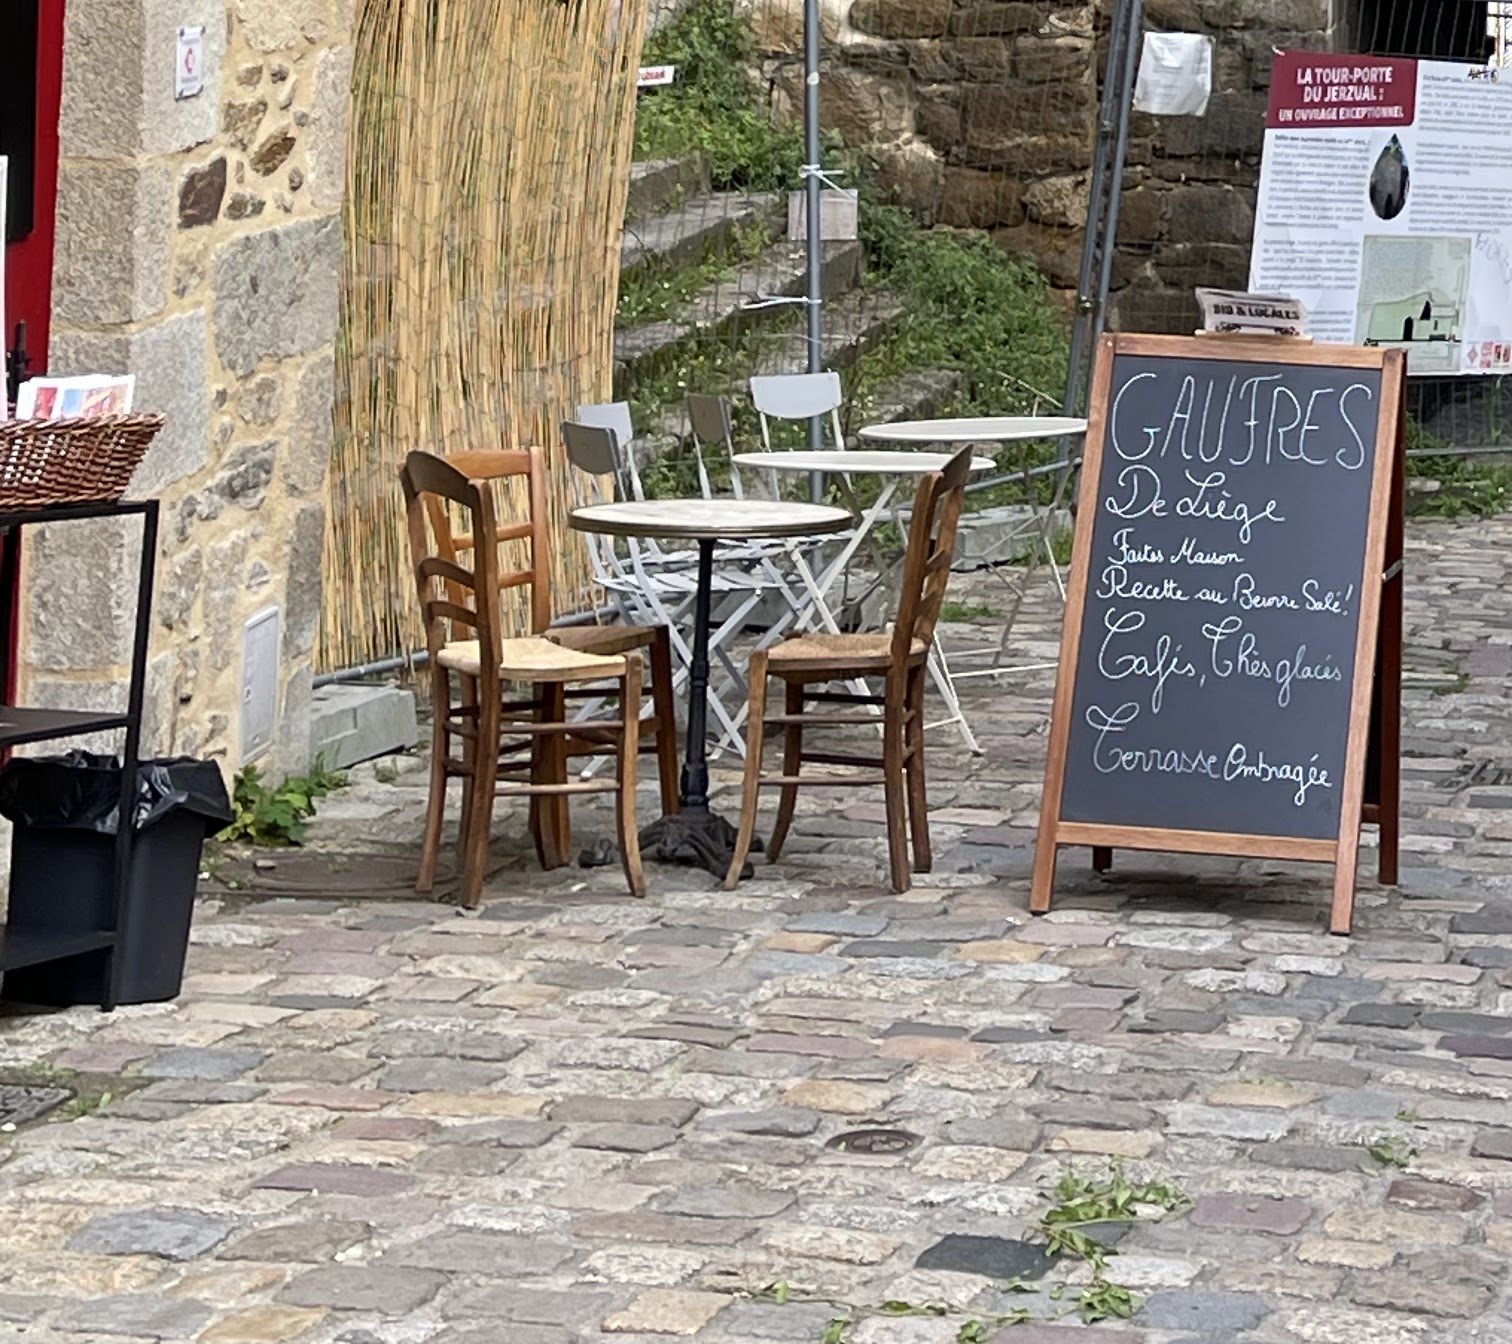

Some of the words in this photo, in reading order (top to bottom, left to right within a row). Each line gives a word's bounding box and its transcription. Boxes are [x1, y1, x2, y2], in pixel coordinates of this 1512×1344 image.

[1297, 68, 1312, 85] LA
[1315, 66, 1393, 84] TOUR-PORTE
[1303, 86, 1322, 103] DU
[1324, 85, 1376, 102] JERZUAL
[1278, 109, 1293, 121] UN
[1294, 108, 1337, 121] OUVRAGE
[1339, 106, 1404, 120] EXCEPTIONNEL
[1111, 373, 1373, 470] GAUFRES
[1105, 464, 1169, 519] De
[1176, 468, 1286, 544] Liège
[1107, 527, 1165, 565] Faites
[1170, 537, 1245, 565] Maison
[1095, 565, 1190, 602] Recette
[1194, 588, 1228, 604] au
[1085, 702, 1221, 779] Terrasse
[1224, 743, 1332, 806] Ombragée
